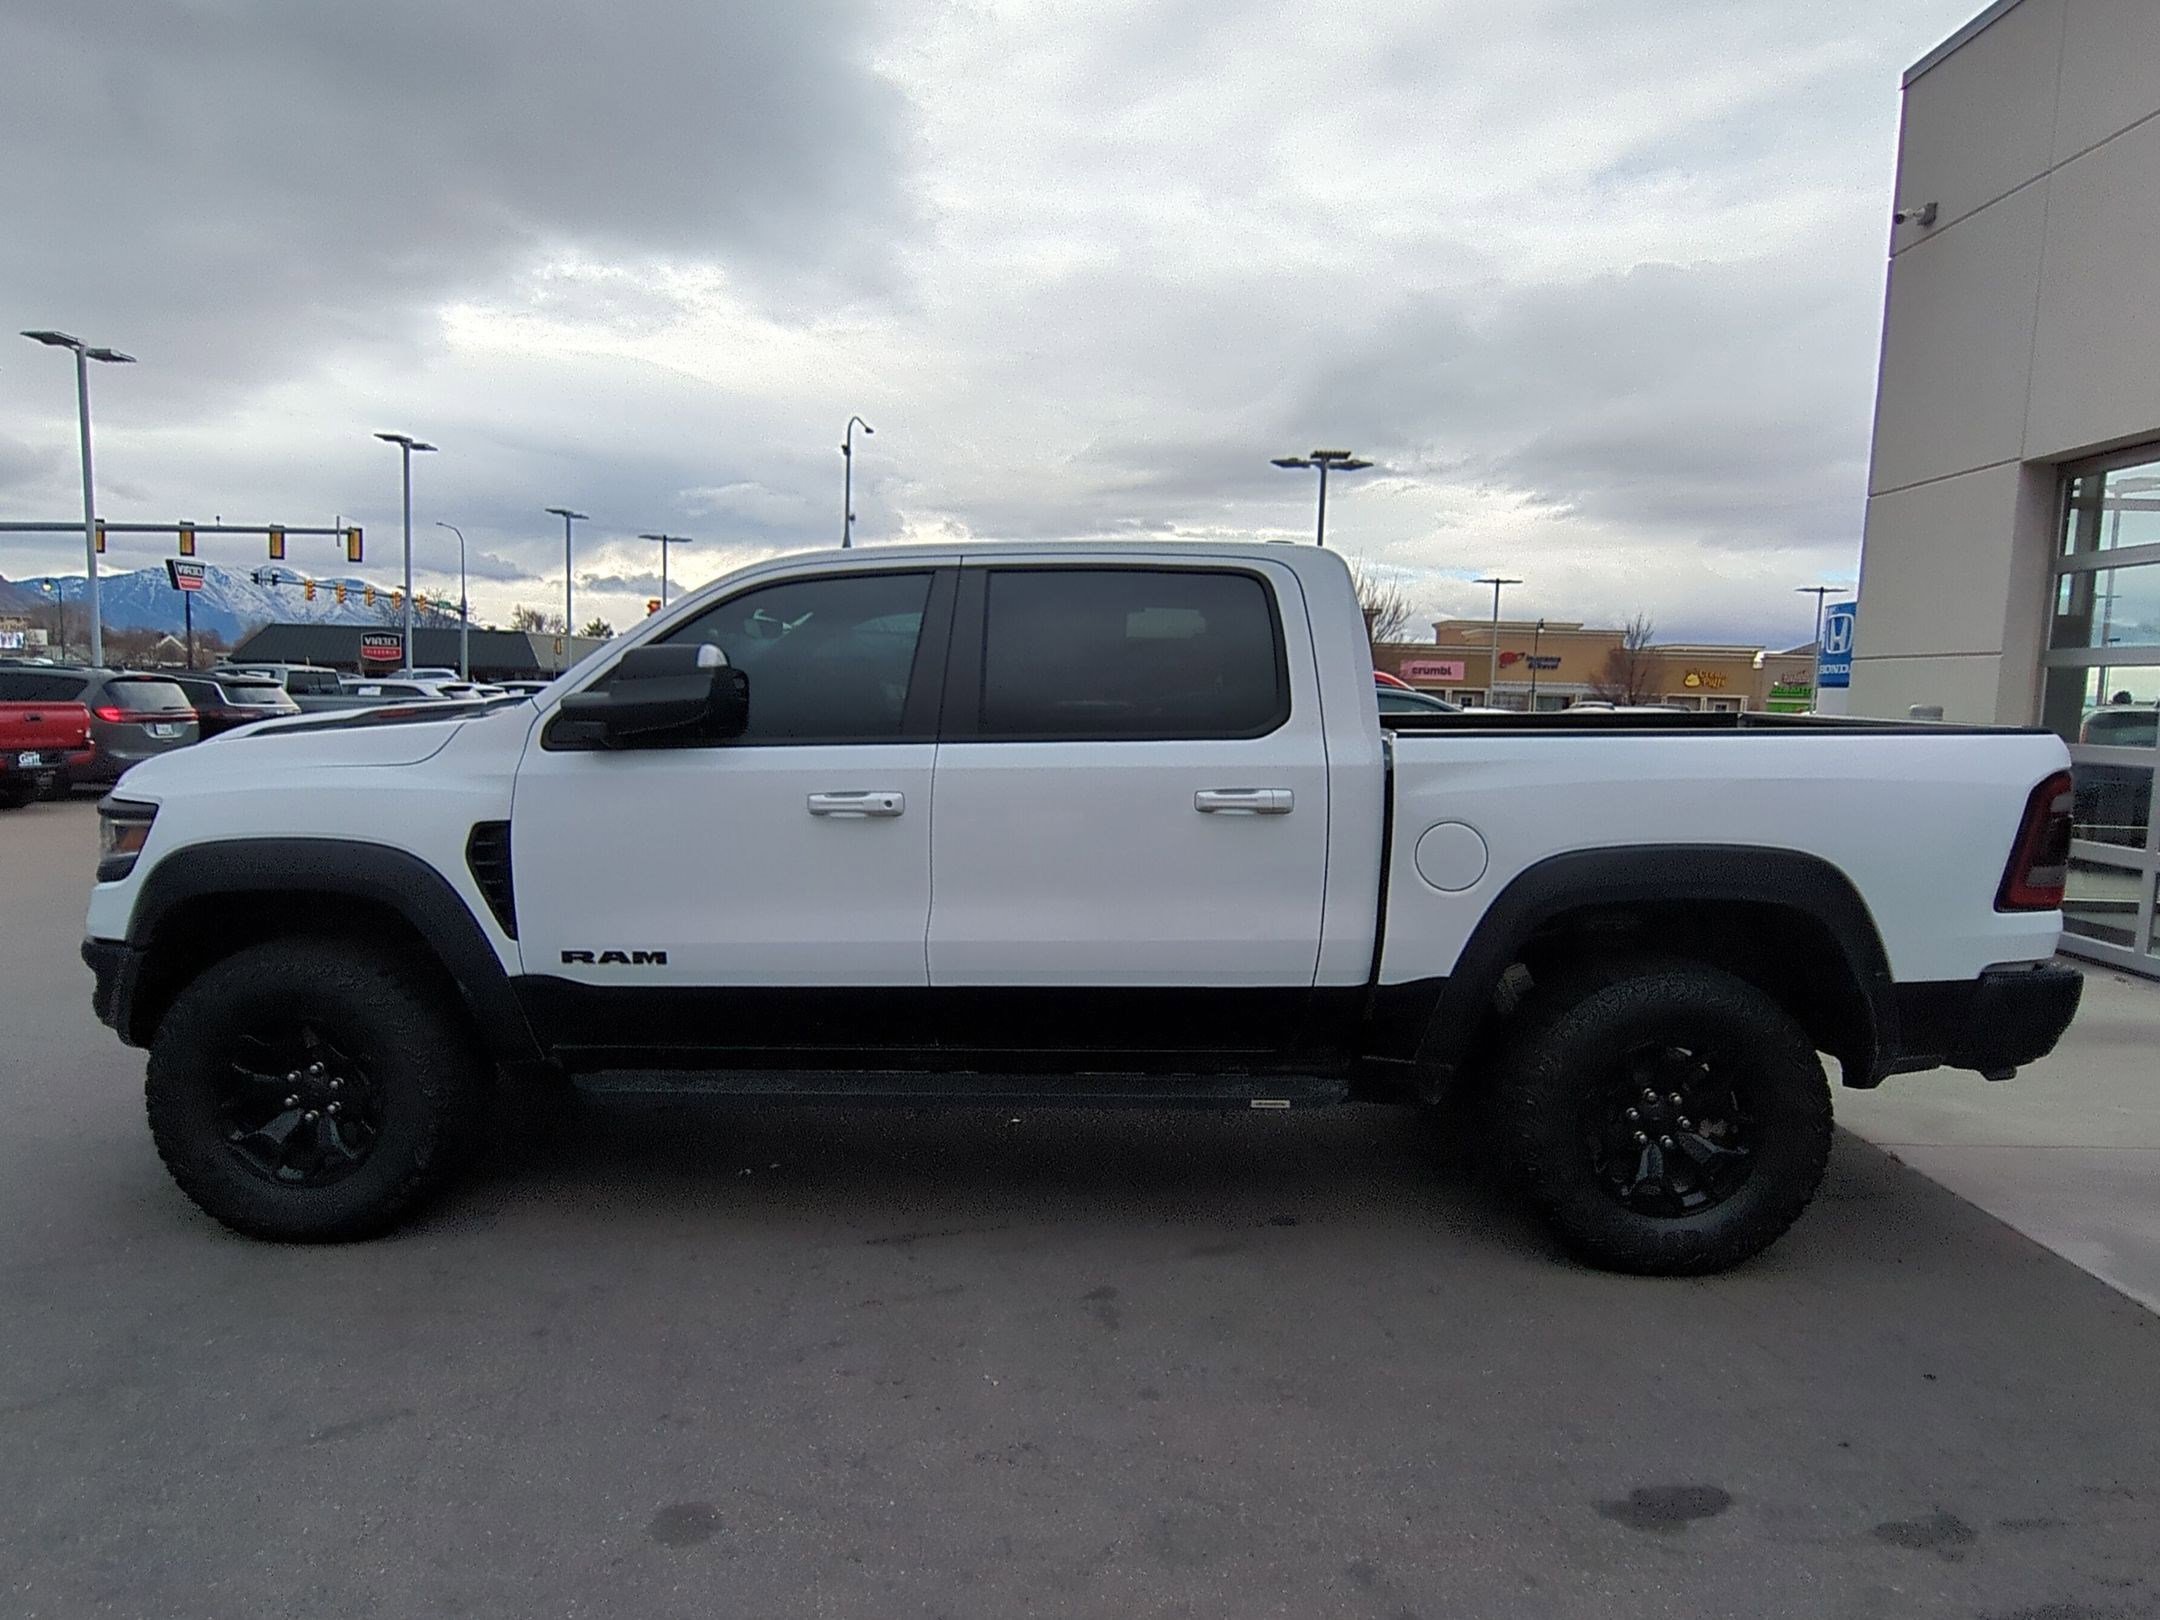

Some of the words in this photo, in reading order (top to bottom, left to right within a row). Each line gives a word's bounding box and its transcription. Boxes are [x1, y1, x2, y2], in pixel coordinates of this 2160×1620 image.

[1412, 666, 1452, 676] crumbl
[1819, 664, 1850, 674] HOND
[561, 950, 668, 965] RAM
